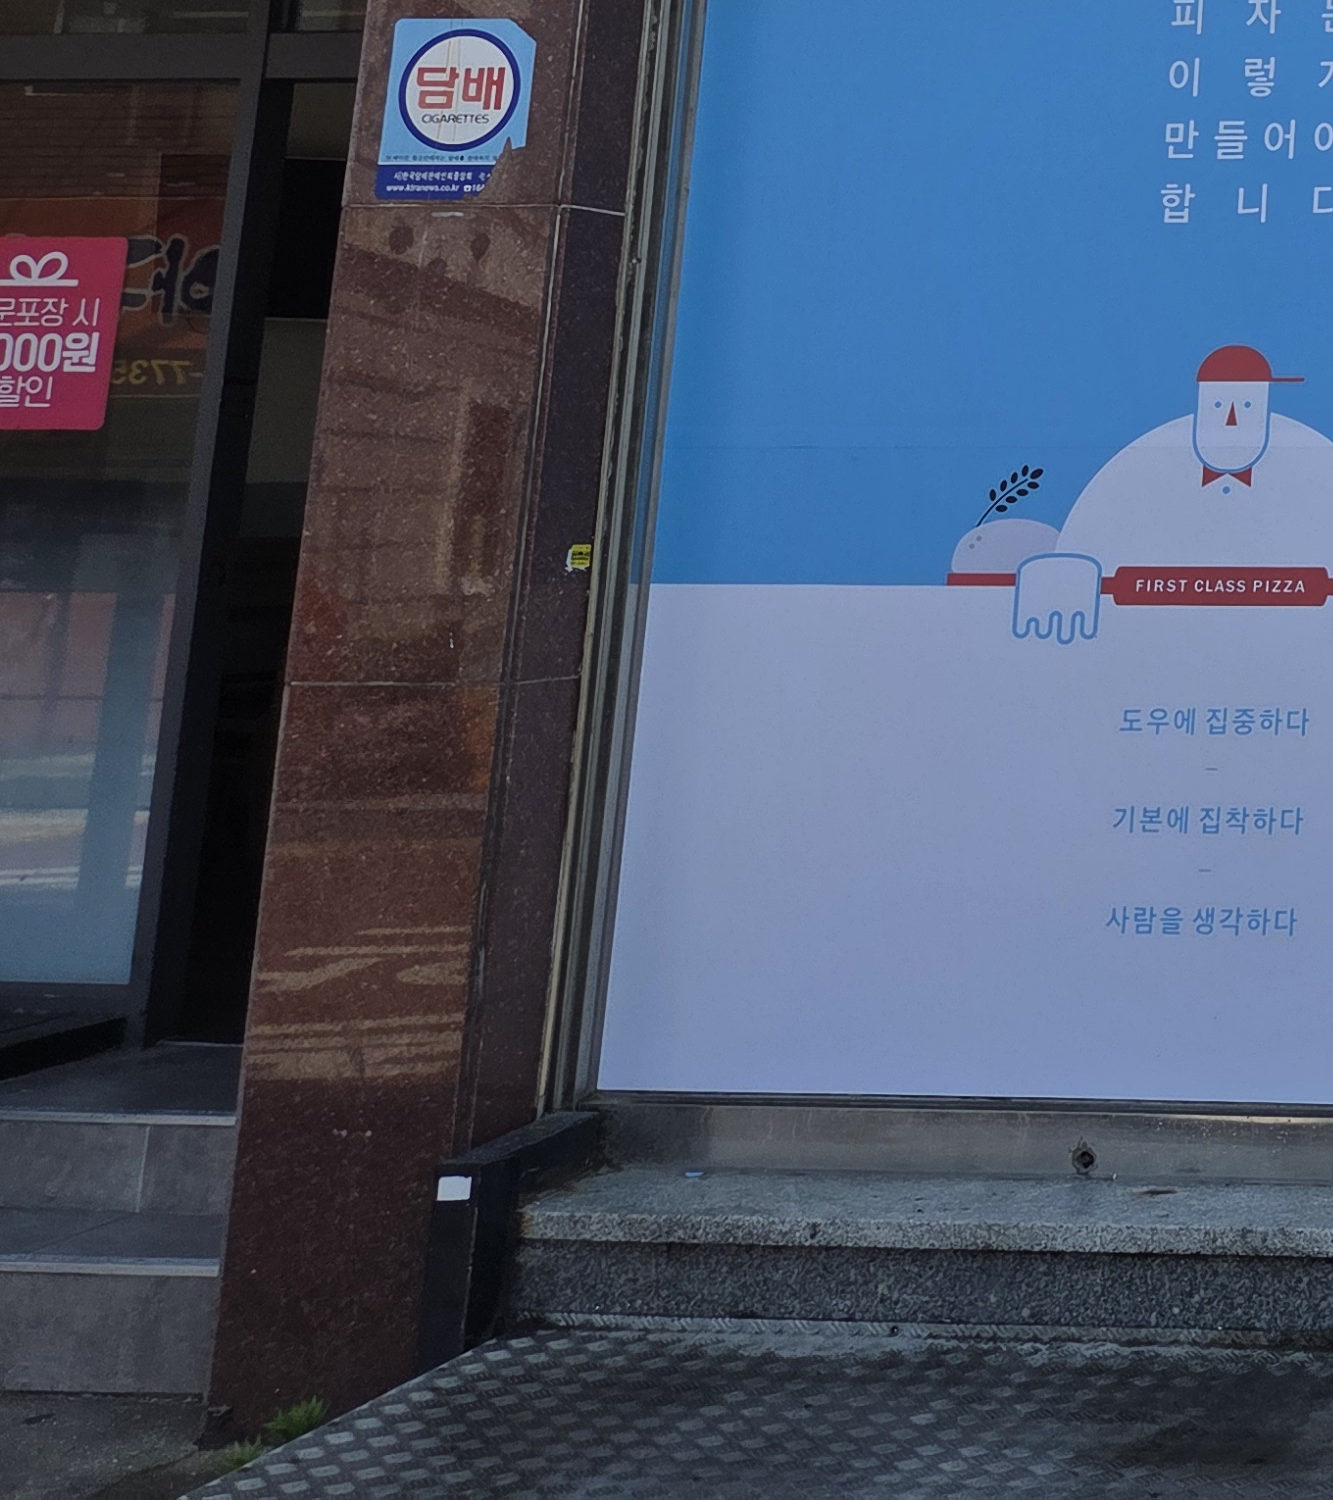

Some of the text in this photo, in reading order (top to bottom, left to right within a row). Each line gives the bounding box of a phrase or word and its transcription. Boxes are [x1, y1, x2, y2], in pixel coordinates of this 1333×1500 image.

[416, 66, 506, 111] 담배
[421, 113, 490, 125] CIGARETTES
[72, 297, 101, 328] 시
[1136, 579, 1305, 593] FIRST CLASS PIZZA
[1119, 706, 1310, 737] 도우에 집중하다
[1112, 805, 1305, 836] 기본에 집착하다
[1105, 905, 1298, 937] 사람을 생각하다
